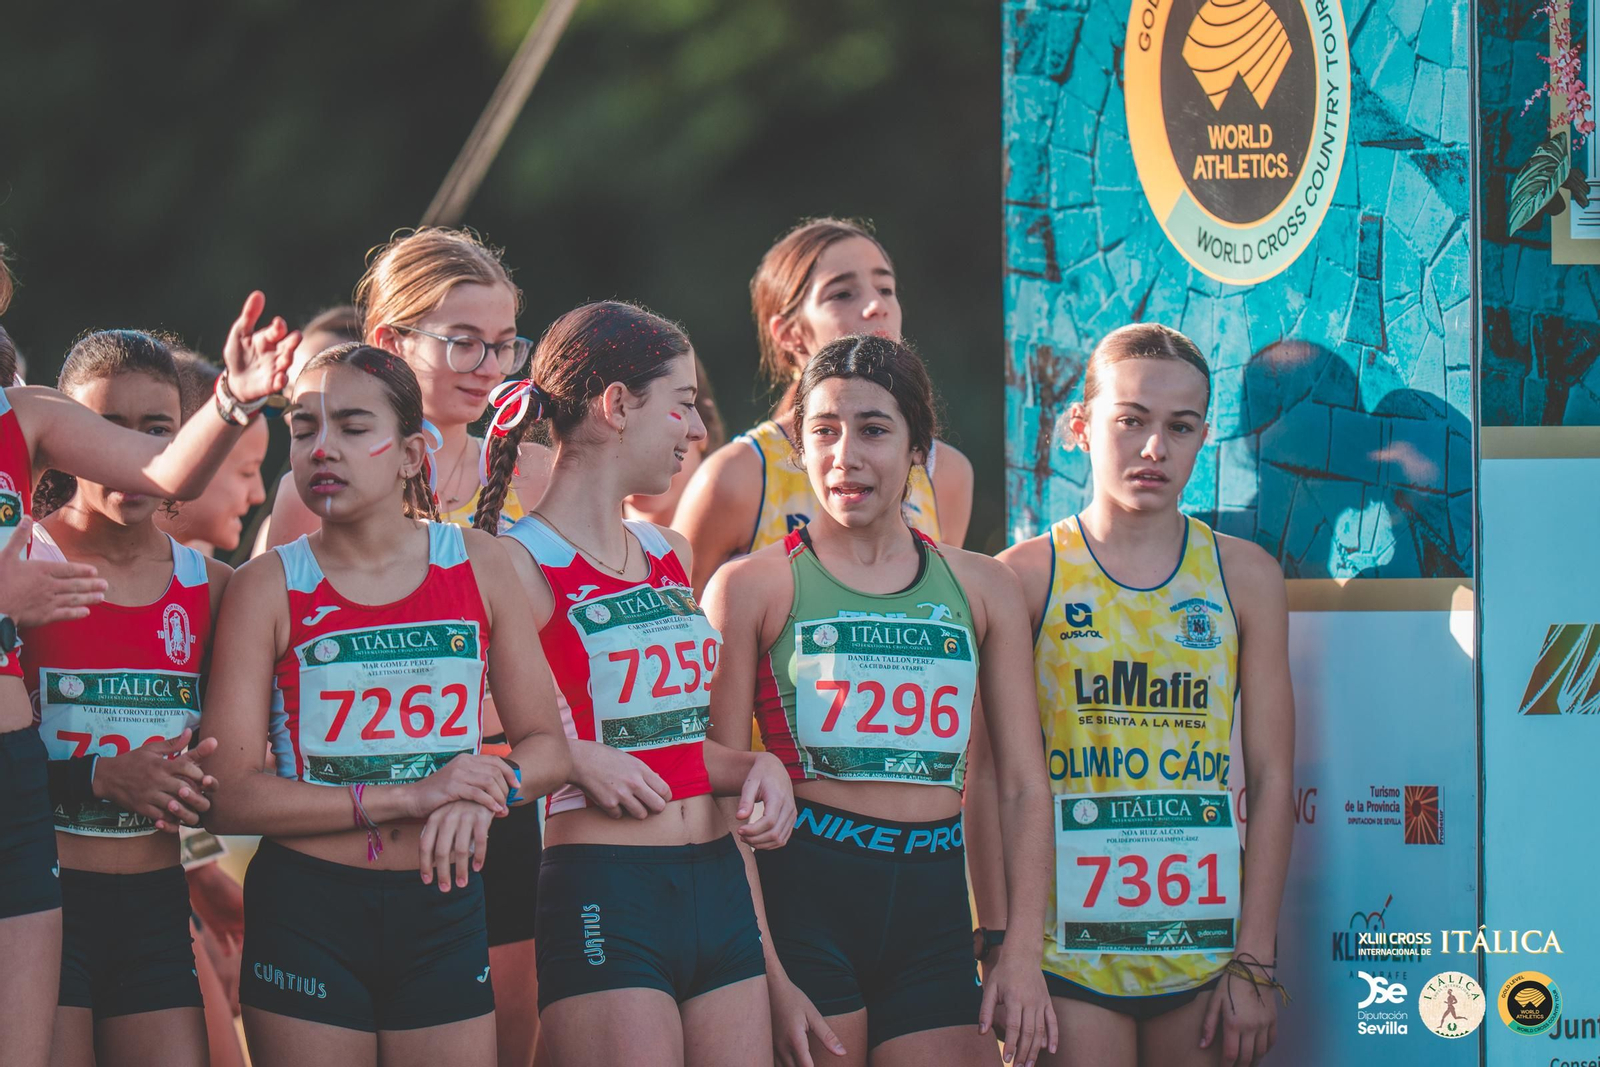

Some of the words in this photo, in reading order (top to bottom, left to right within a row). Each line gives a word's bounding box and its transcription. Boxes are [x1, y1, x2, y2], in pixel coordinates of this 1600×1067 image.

[1315, 0, 1338, 73] TOUR
[1208, 124, 1273, 150] WORLD
[1305, 79, 1340, 207] COUNTRY
[1193, 153, 1289, 180] ATHLETICS
[1257, 205, 1307, 260] CROSS
[1197, 226, 1253, 264] WORLD
[616, 591, 681, 616] ITÁLIA
[628, 620, 654, 630] CARMEN
[642, 625, 670, 635] ATLETISMO
[851, 622, 932, 646] ITÁLICA
[1060, 630, 1103, 641] austral
[351, 630, 438, 651] ITÁLICA
[361, 662, 379, 670] MAR
[380, 661, 409, 669] GOMEZ
[410, 659, 435, 667] PEREZ
[608, 638, 717, 704] 7259
[847, 654, 881, 662] DANIELA
[881, 656, 912, 664] TALLON
[912, 657, 936, 665] PEREZ
[97, 673, 173, 697] ITÁLICA
[368, 669, 403, 677] ATLETISMO
[1074, 660, 1209, 709] LaMafia
[82, 706, 117, 715] VALERIA
[118, 708, 154, 716] CORONEL
[154, 709, 185, 717] OLIVEIRA
[319, 683, 468, 742] 7262
[815, 680, 960, 738] 7296
[1078, 715, 1093, 725] SE
[1096, 716, 1136, 727] SIENTA
[1140, 719, 1149, 727] A
[1153, 719, 1170, 728] LA
[1174, 719, 1206, 729] MESA
[1050, 746, 1149, 781] OLIMPO
[1159, 740, 1230, 786] CÁDIZ
[1370, 785, 1400, 798] Turismo
[1110, 796, 1192, 818] ITÁLICA
[1345, 800, 1354, 812] de
[1356, 800, 1364, 812] la
[1366, 800, 1400, 812] Provincia
[794, 807, 902, 853] NIKE
[904, 822, 963, 854] PRO
[1106, 836, 1156, 844] POLIDEPORTIVO
[1158, 828, 1184, 836] ALCON
[1076, 853, 1227, 908] 7361
[581, 903, 606, 966] CURTIUS
[254, 962, 327, 999] CURTIUS
